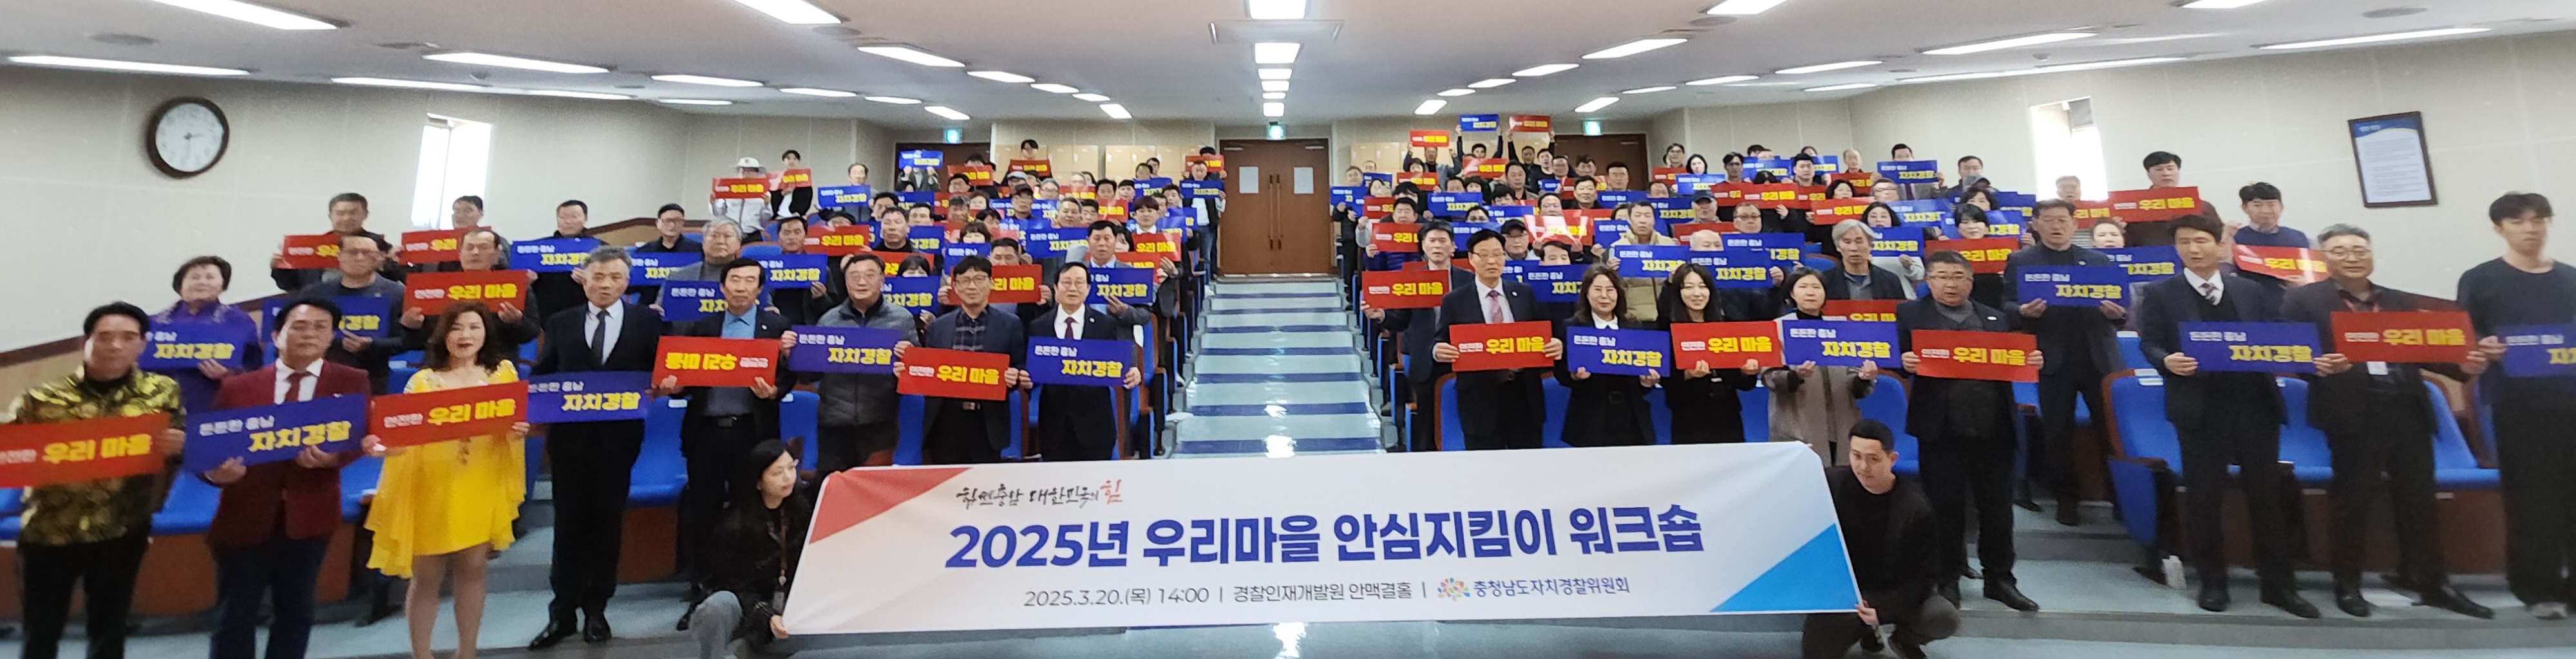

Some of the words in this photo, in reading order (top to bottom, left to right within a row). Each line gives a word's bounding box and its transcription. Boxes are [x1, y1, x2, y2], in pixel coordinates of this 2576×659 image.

[771, 268, 820, 281] 자치경찰
[1716, 268, 1766, 280] 자치경찰
[448, 285, 481, 299] 우리
[485, 284, 516, 298] 마을
[1010, 277, 1034, 290] 마을
[1097, 284, 1147, 297] 자치경찰
[1393, 283, 1416, 295] 우리
[1419, 283, 1443, 294] 마을
[2056, 285, 2121, 298] 자치경찰
[1486, 339, 1514, 353] 우리
[1517, 337, 1544, 352] 마을
[1709, 338, 1738, 353] 우리
[1741, 337, 1772, 351] 마을
[2383, 330, 2423, 345] 우리
[2427, 329, 2465, 345] 마을
[828, 348, 892, 364] 자치경찰
[1602, 349, 1662, 367] 자치경찰
[1822, 342, 1890, 358] 자치경찰
[1953, 348, 1987, 362] 우리
[1991, 349, 2025, 366] 마을
[2230, 346, 2312, 362] 자치경찰
[703, 354, 737, 369] 우리
[1062, 360, 1122, 377] 자치경찰
[937, 366, 967, 382] 우리
[970, 368, 998, 384] 마을
[563, 393, 640, 410] 자치경찰
[429, 404, 471, 425] 우리
[475, 399, 515, 419] 마을
[246, 420, 350, 452] 자치경찰
[44, 440, 95, 463] 우리
[1099, 479, 1124, 504] 힘
[945, 521, 1129, 568] 2025년
[1144, 515, 1320, 567] 우리마을
[1334, 508, 1557, 561] 안심지킴이
[1569, 504, 1704, 555] 워크숍
[1023, 587, 1151, 608] 2025.3.20.(목)
[1158, 587, 1209, 604] 14:00
[1233, 583, 1345, 603] 경찰인재개발원
[1349, 582, 1412, 600] 안맥결홀
[1473, 577, 1631, 597] 충청남도자치경찰위원회
